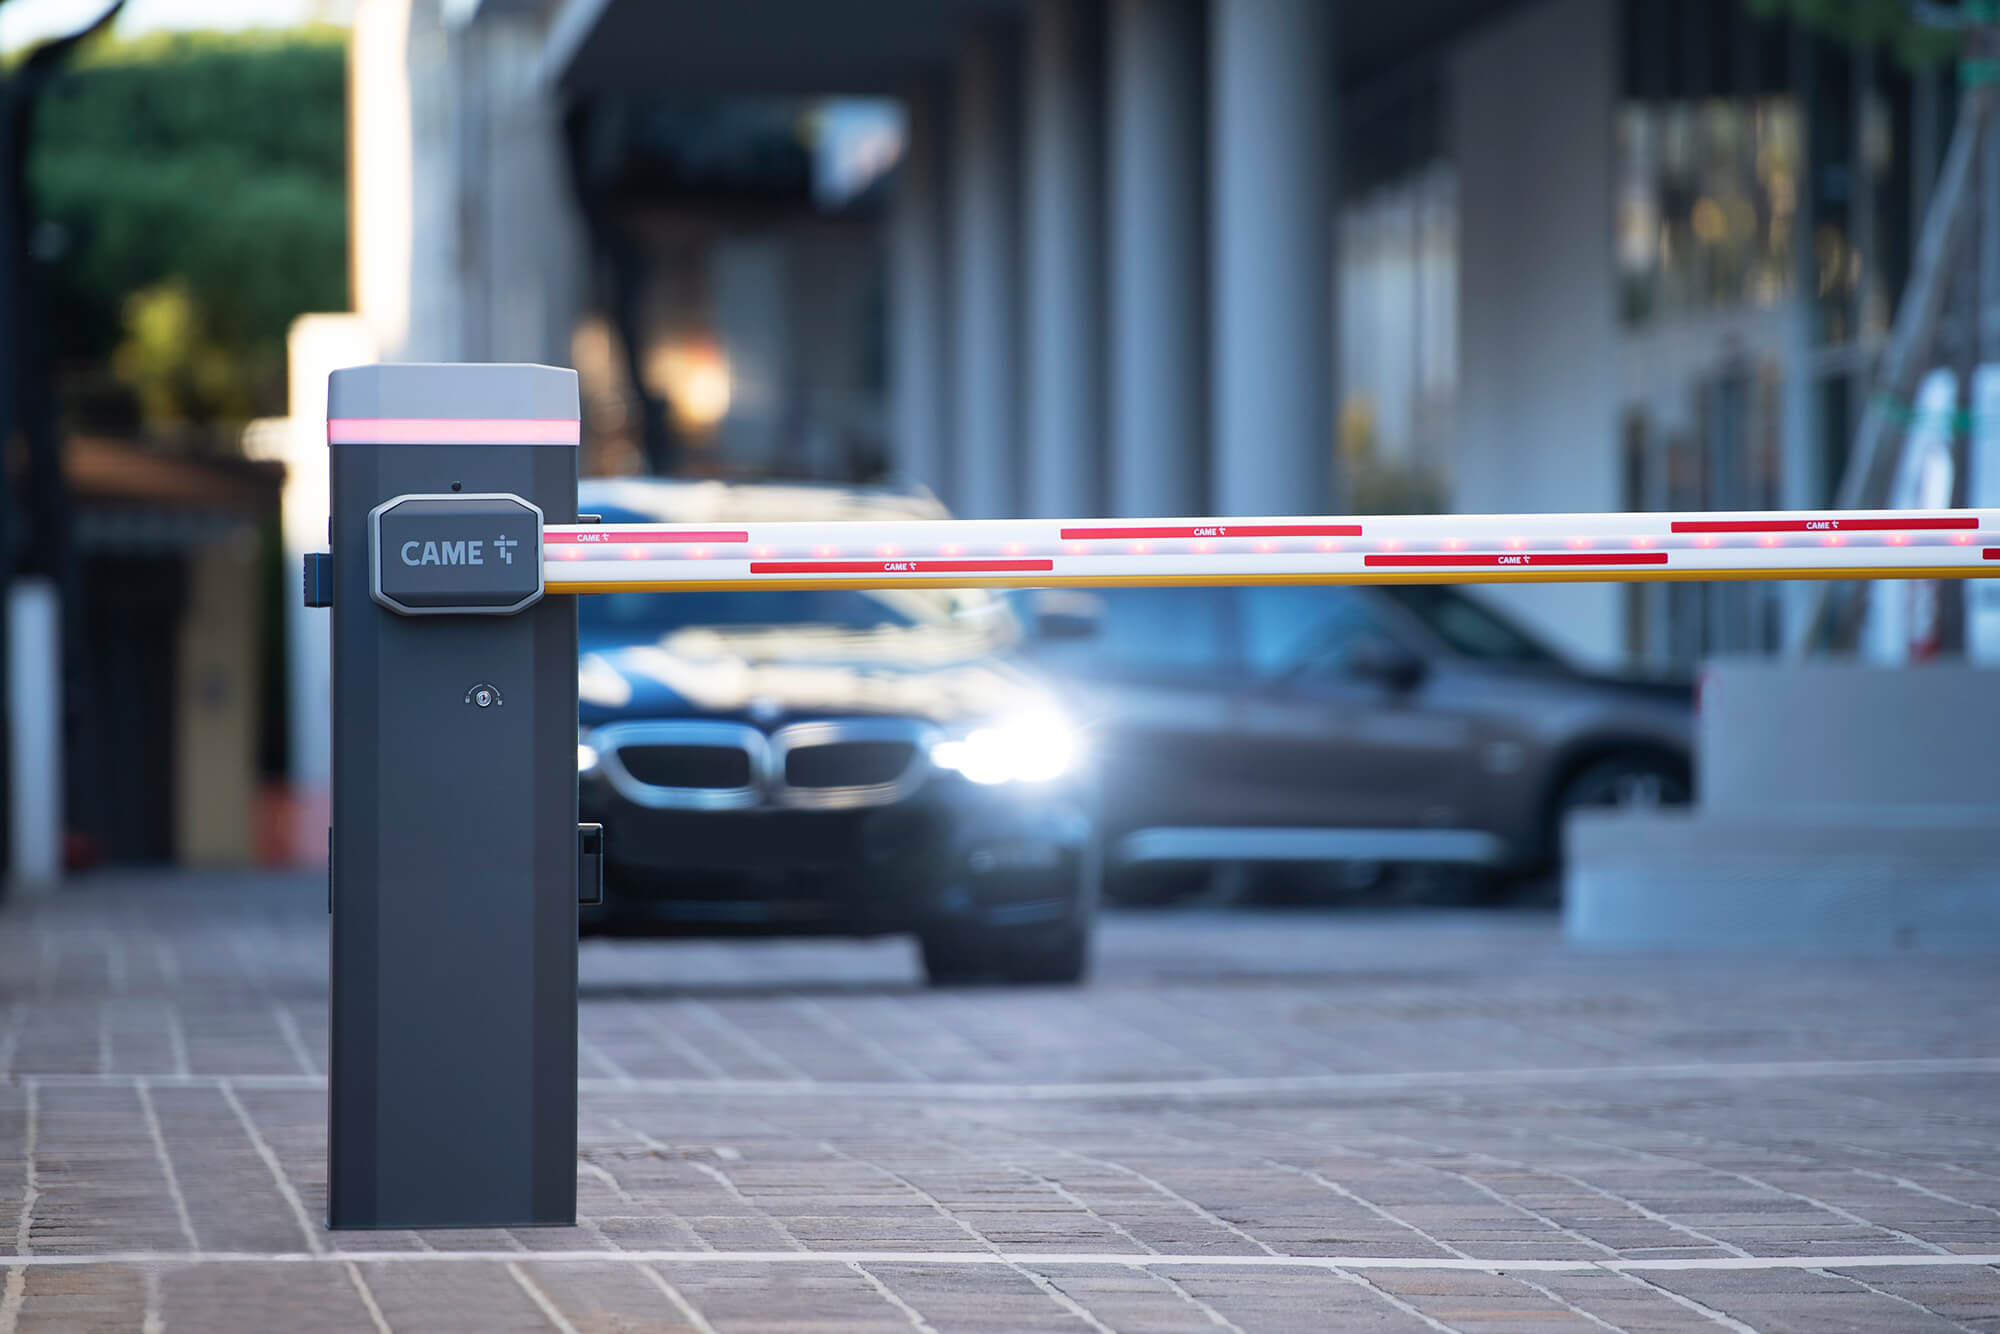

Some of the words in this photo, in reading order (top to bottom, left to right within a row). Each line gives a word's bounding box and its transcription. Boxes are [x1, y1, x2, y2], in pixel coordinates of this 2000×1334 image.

[1806, 521, 1829, 530] CAME
[1193, 528, 1217, 536] CAME
[577, 534, 601, 542] CAME
[401, 541, 483, 566] CAME
[1498, 556, 1521, 564] CAME
[884, 563, 907, 571] CAME
